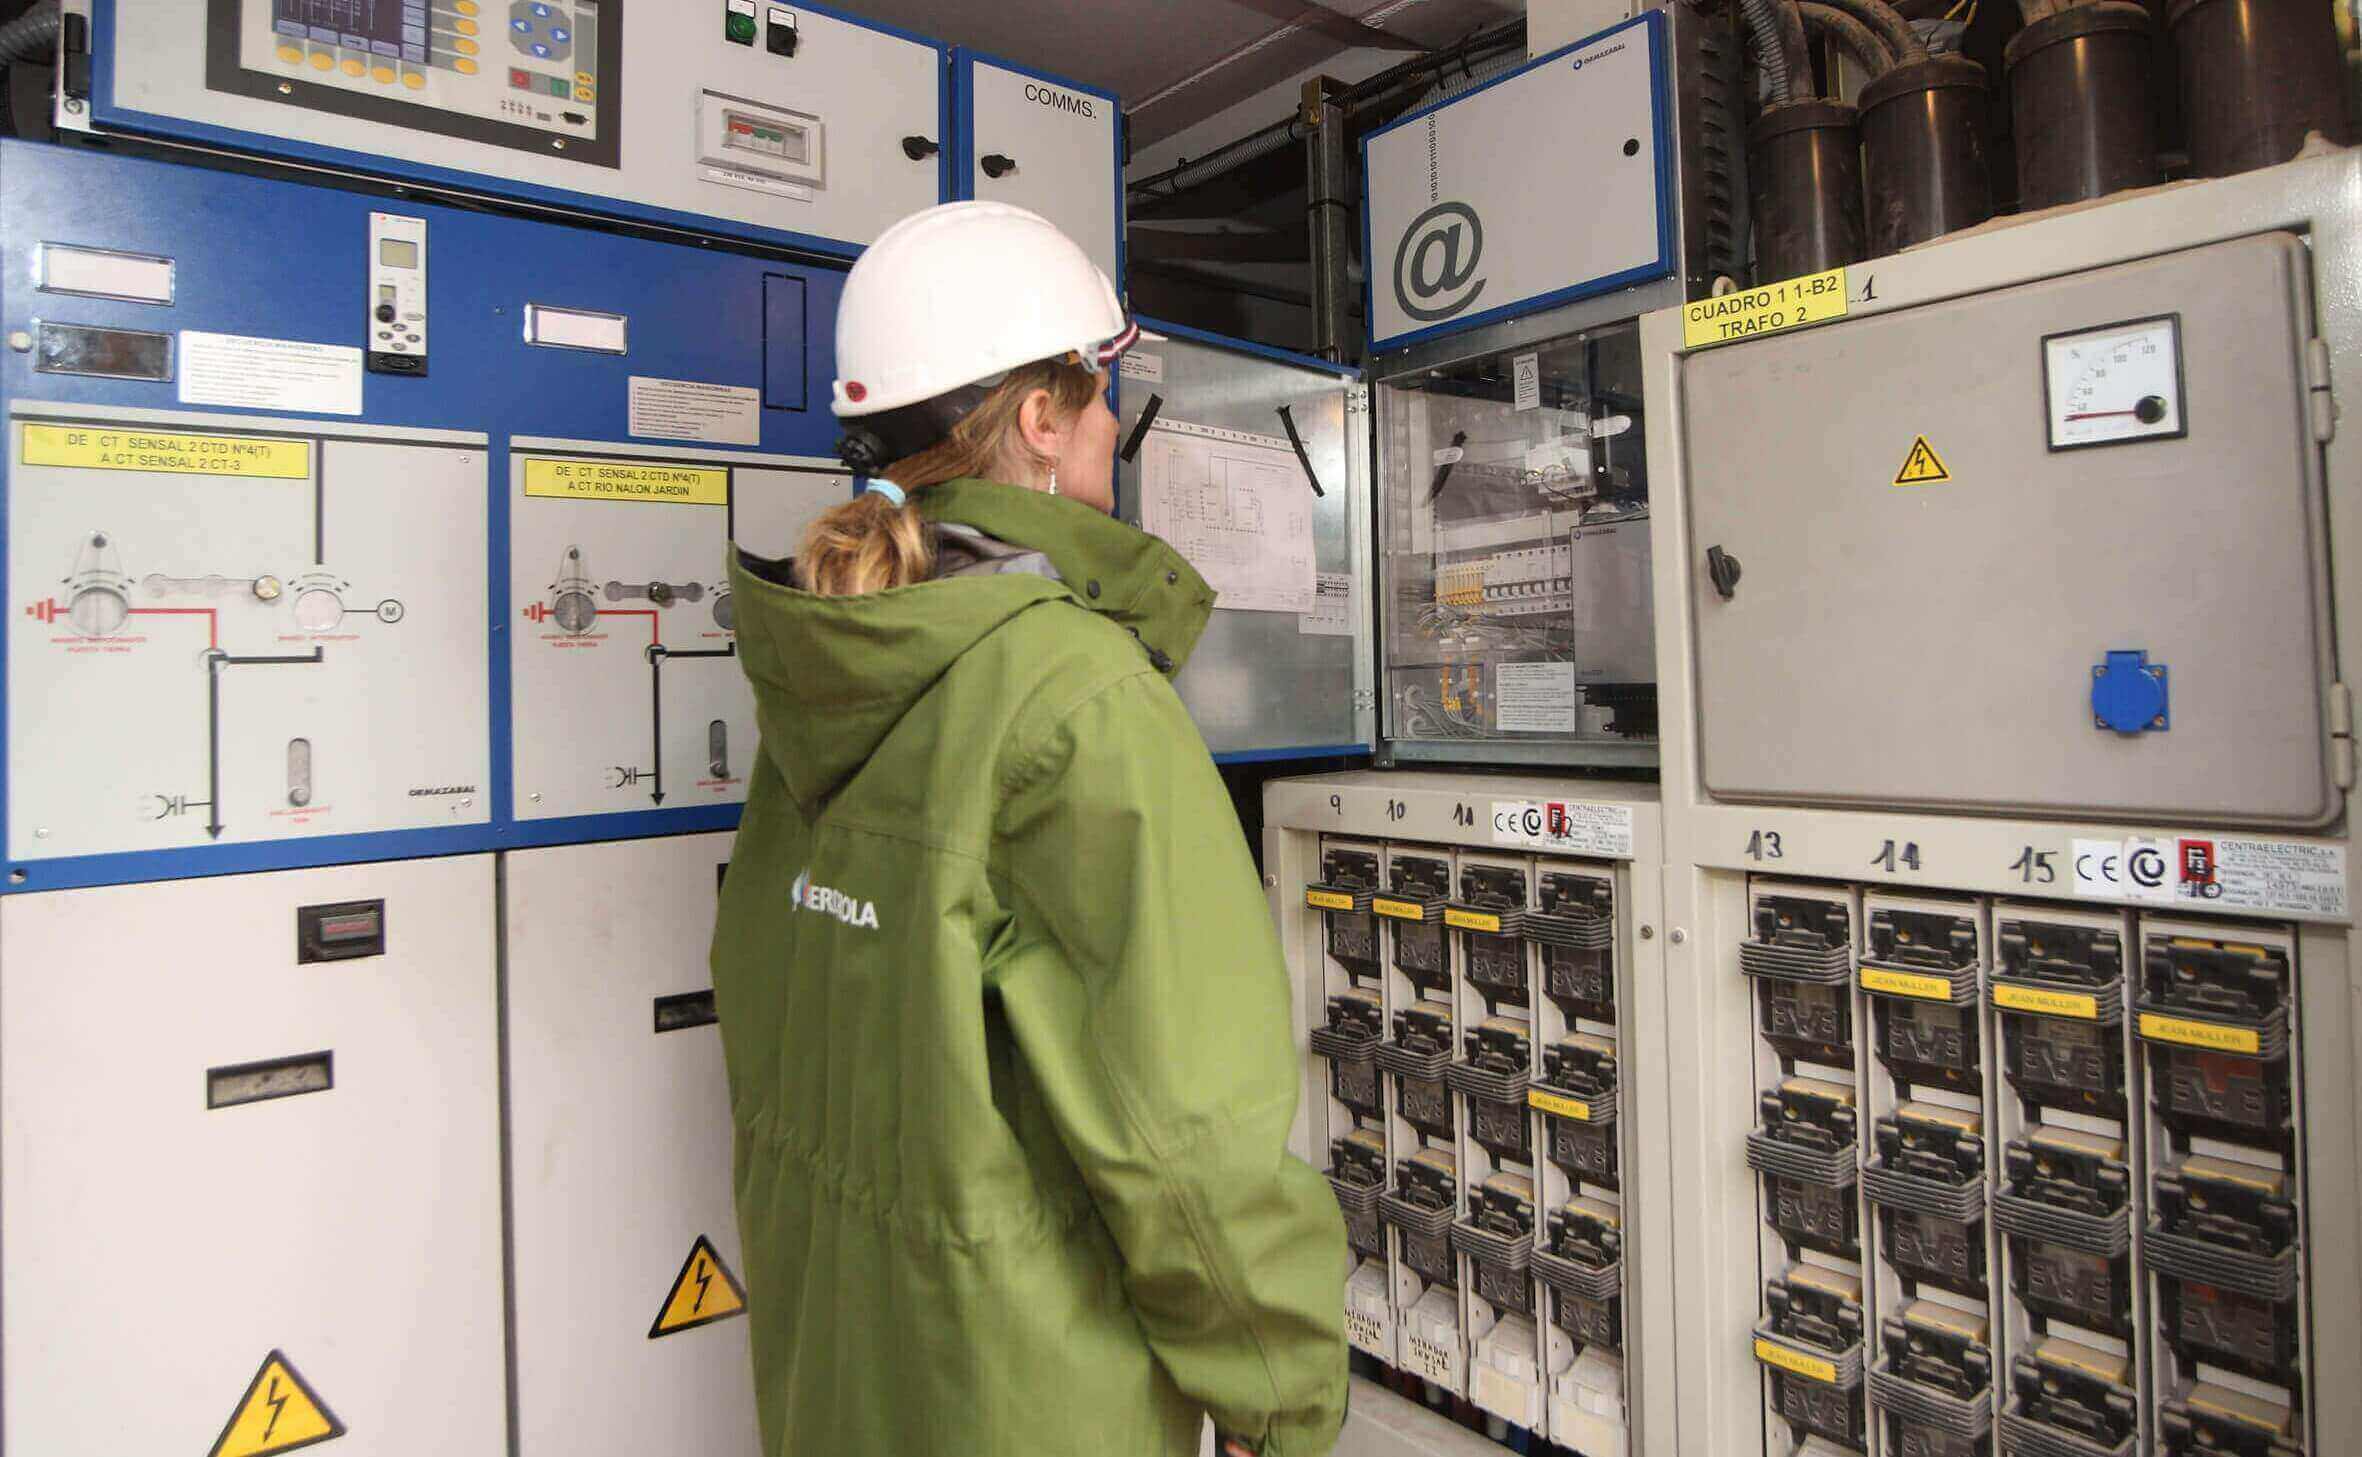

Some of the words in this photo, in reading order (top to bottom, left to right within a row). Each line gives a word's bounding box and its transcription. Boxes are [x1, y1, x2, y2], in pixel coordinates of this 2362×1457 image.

[1025, 84, 1097, 119] COMMS.
[1393, 201, 1486, 321] @
[1690, 291, 1771, 322] CUADRO
[1794, 275, 1838, 299] 1-B2
[1720, 312, 1784, 339] TRAFO
[1796, 307, 1808, 323] 2
[67, 433, 88, 446] DE
[100, 436, 120, 448] CT
[128, 437, 184, 452] SENSAL
[189, 441, 197, 453] 2
[100, 455, 111, 463] A
[116, 455, 134, 466] CT
[139, 456, 195, 469] SENSAL
[200, 458, 207, 469] 2
[211, 459, 241, 471] CT-3
[556, 466, 571, 476] DE
[579, 467, 592, 477] CT
[599, 468, 640, 480] SENSAL
[641, 471, 648, 480] 2
[568, 482, 576, 490] A
[579, 482, 591, 492] CT
[653, 486, 690, 496] JARDIN
[1330, 794, 1342, 816] 9
[1386, 799, 1406, 821] 10
[1745, 830, 1783, 861] 13
[2009, 846, 2058, 883] 15
[2076, 854, 2119, 882] CE
